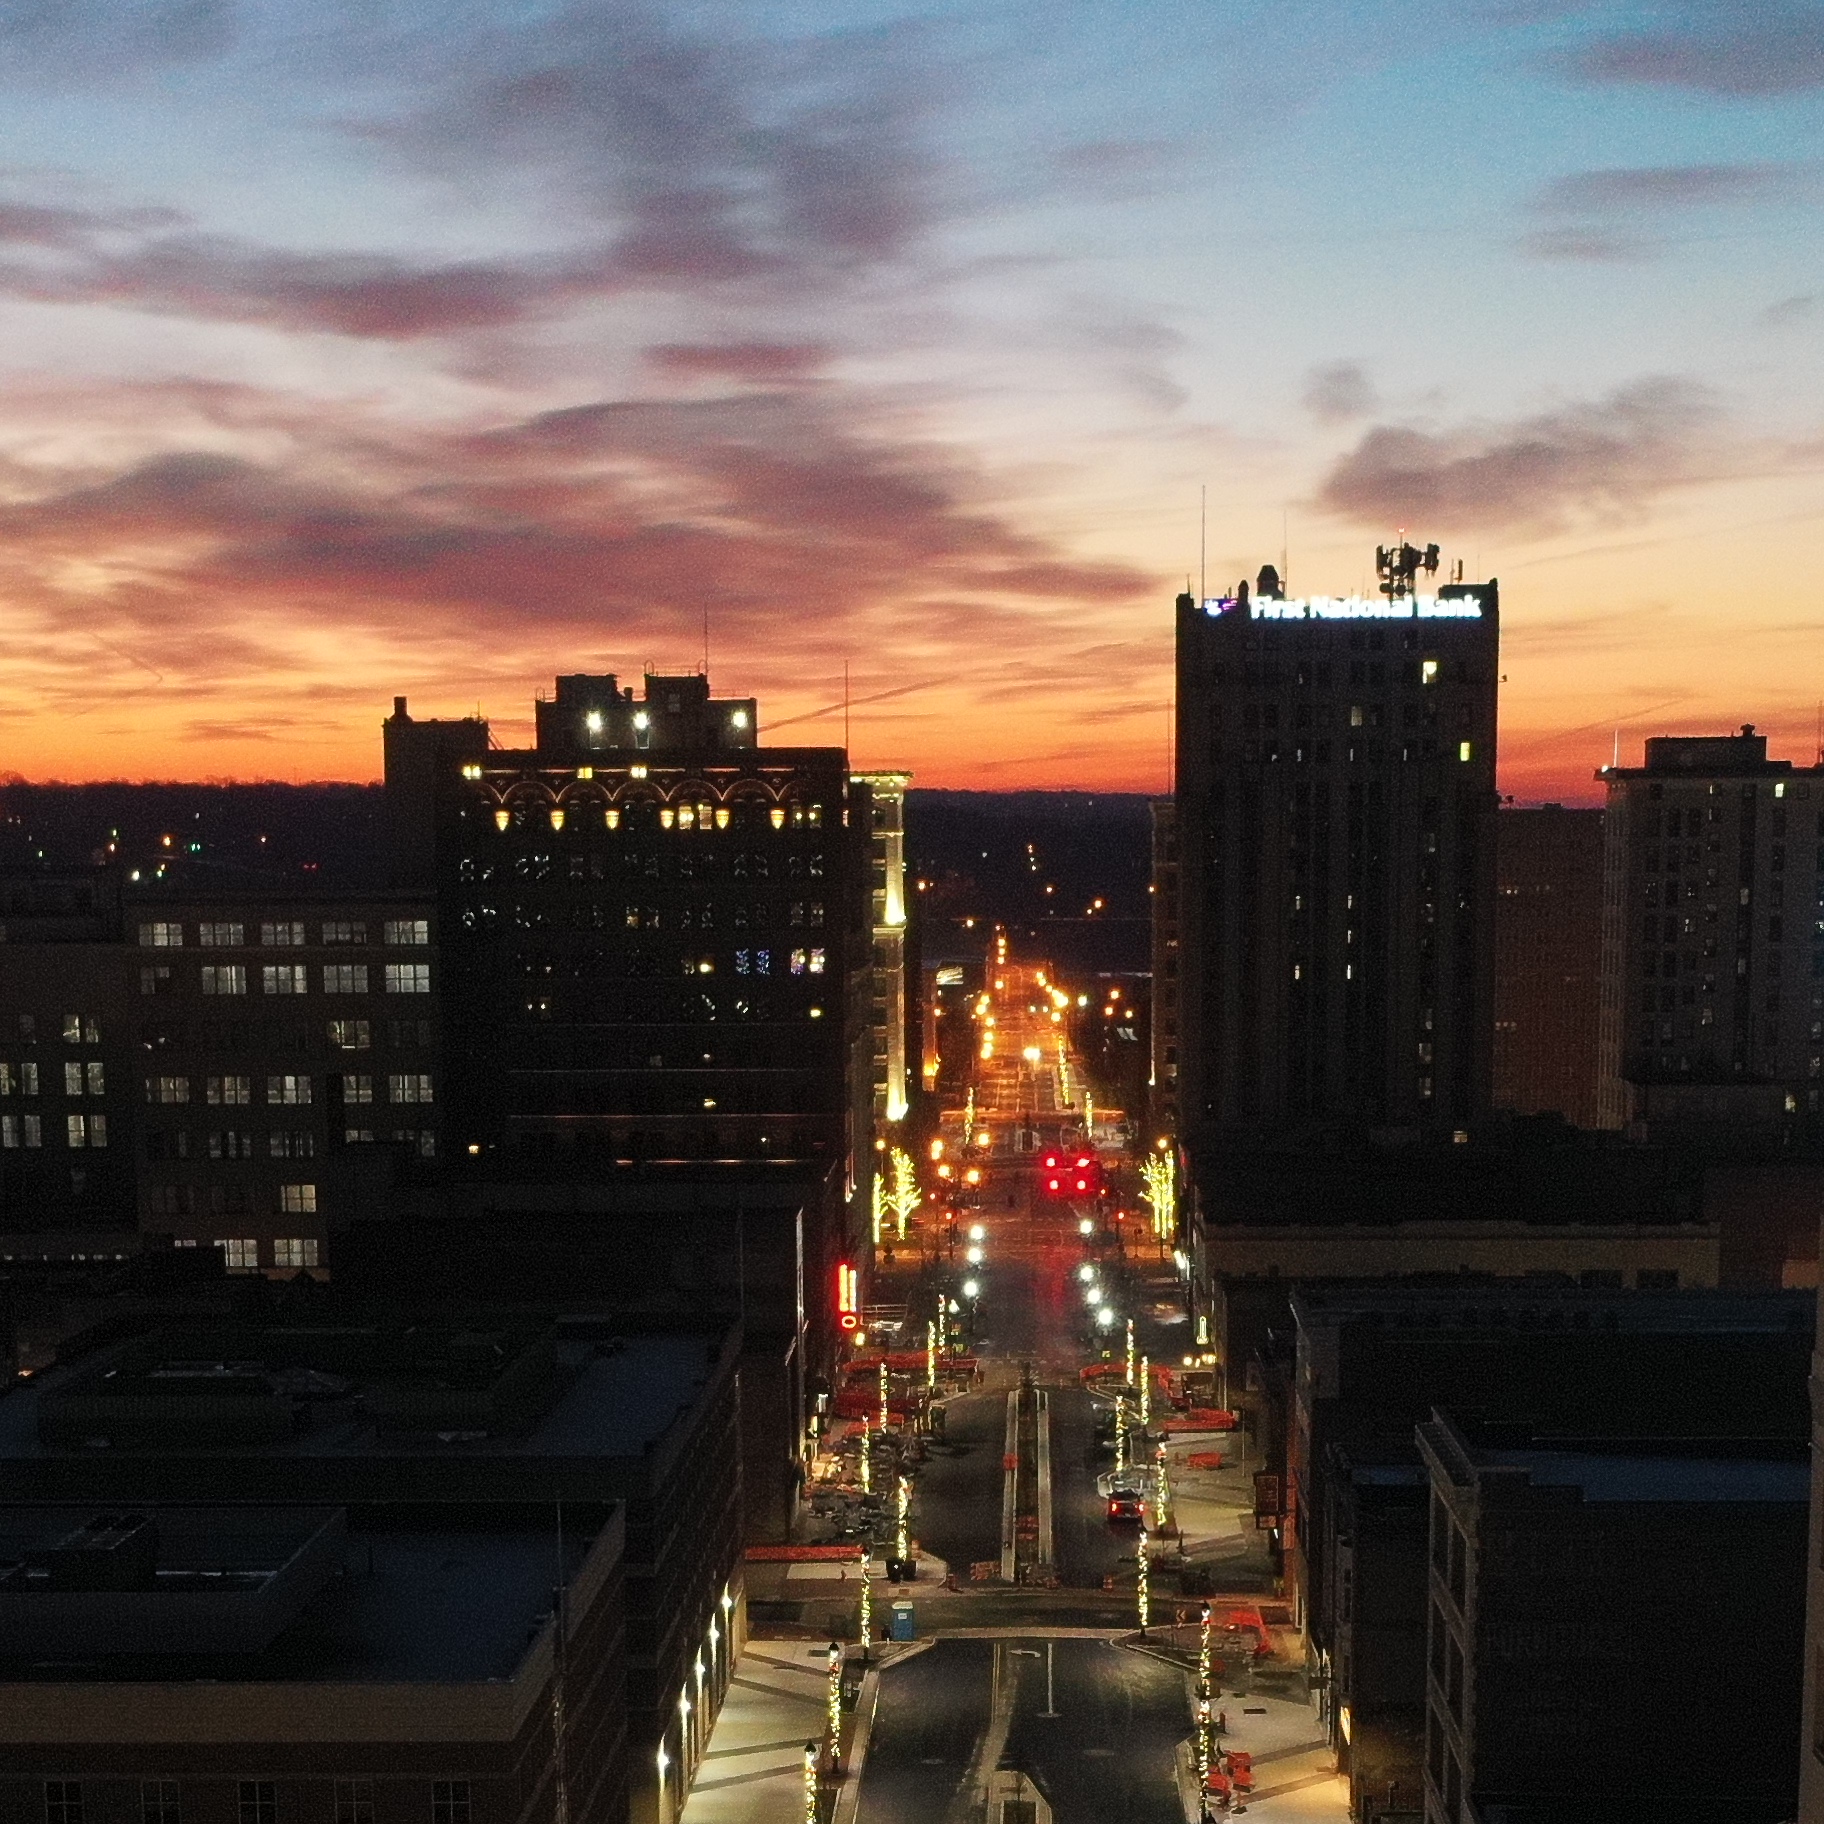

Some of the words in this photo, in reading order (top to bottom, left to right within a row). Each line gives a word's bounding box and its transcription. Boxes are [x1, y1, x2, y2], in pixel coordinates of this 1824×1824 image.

[1251, 595, 1306, 618] First
[1310, 594, 1413, 618] National
[1417, 595, 1482, 618] Bank
